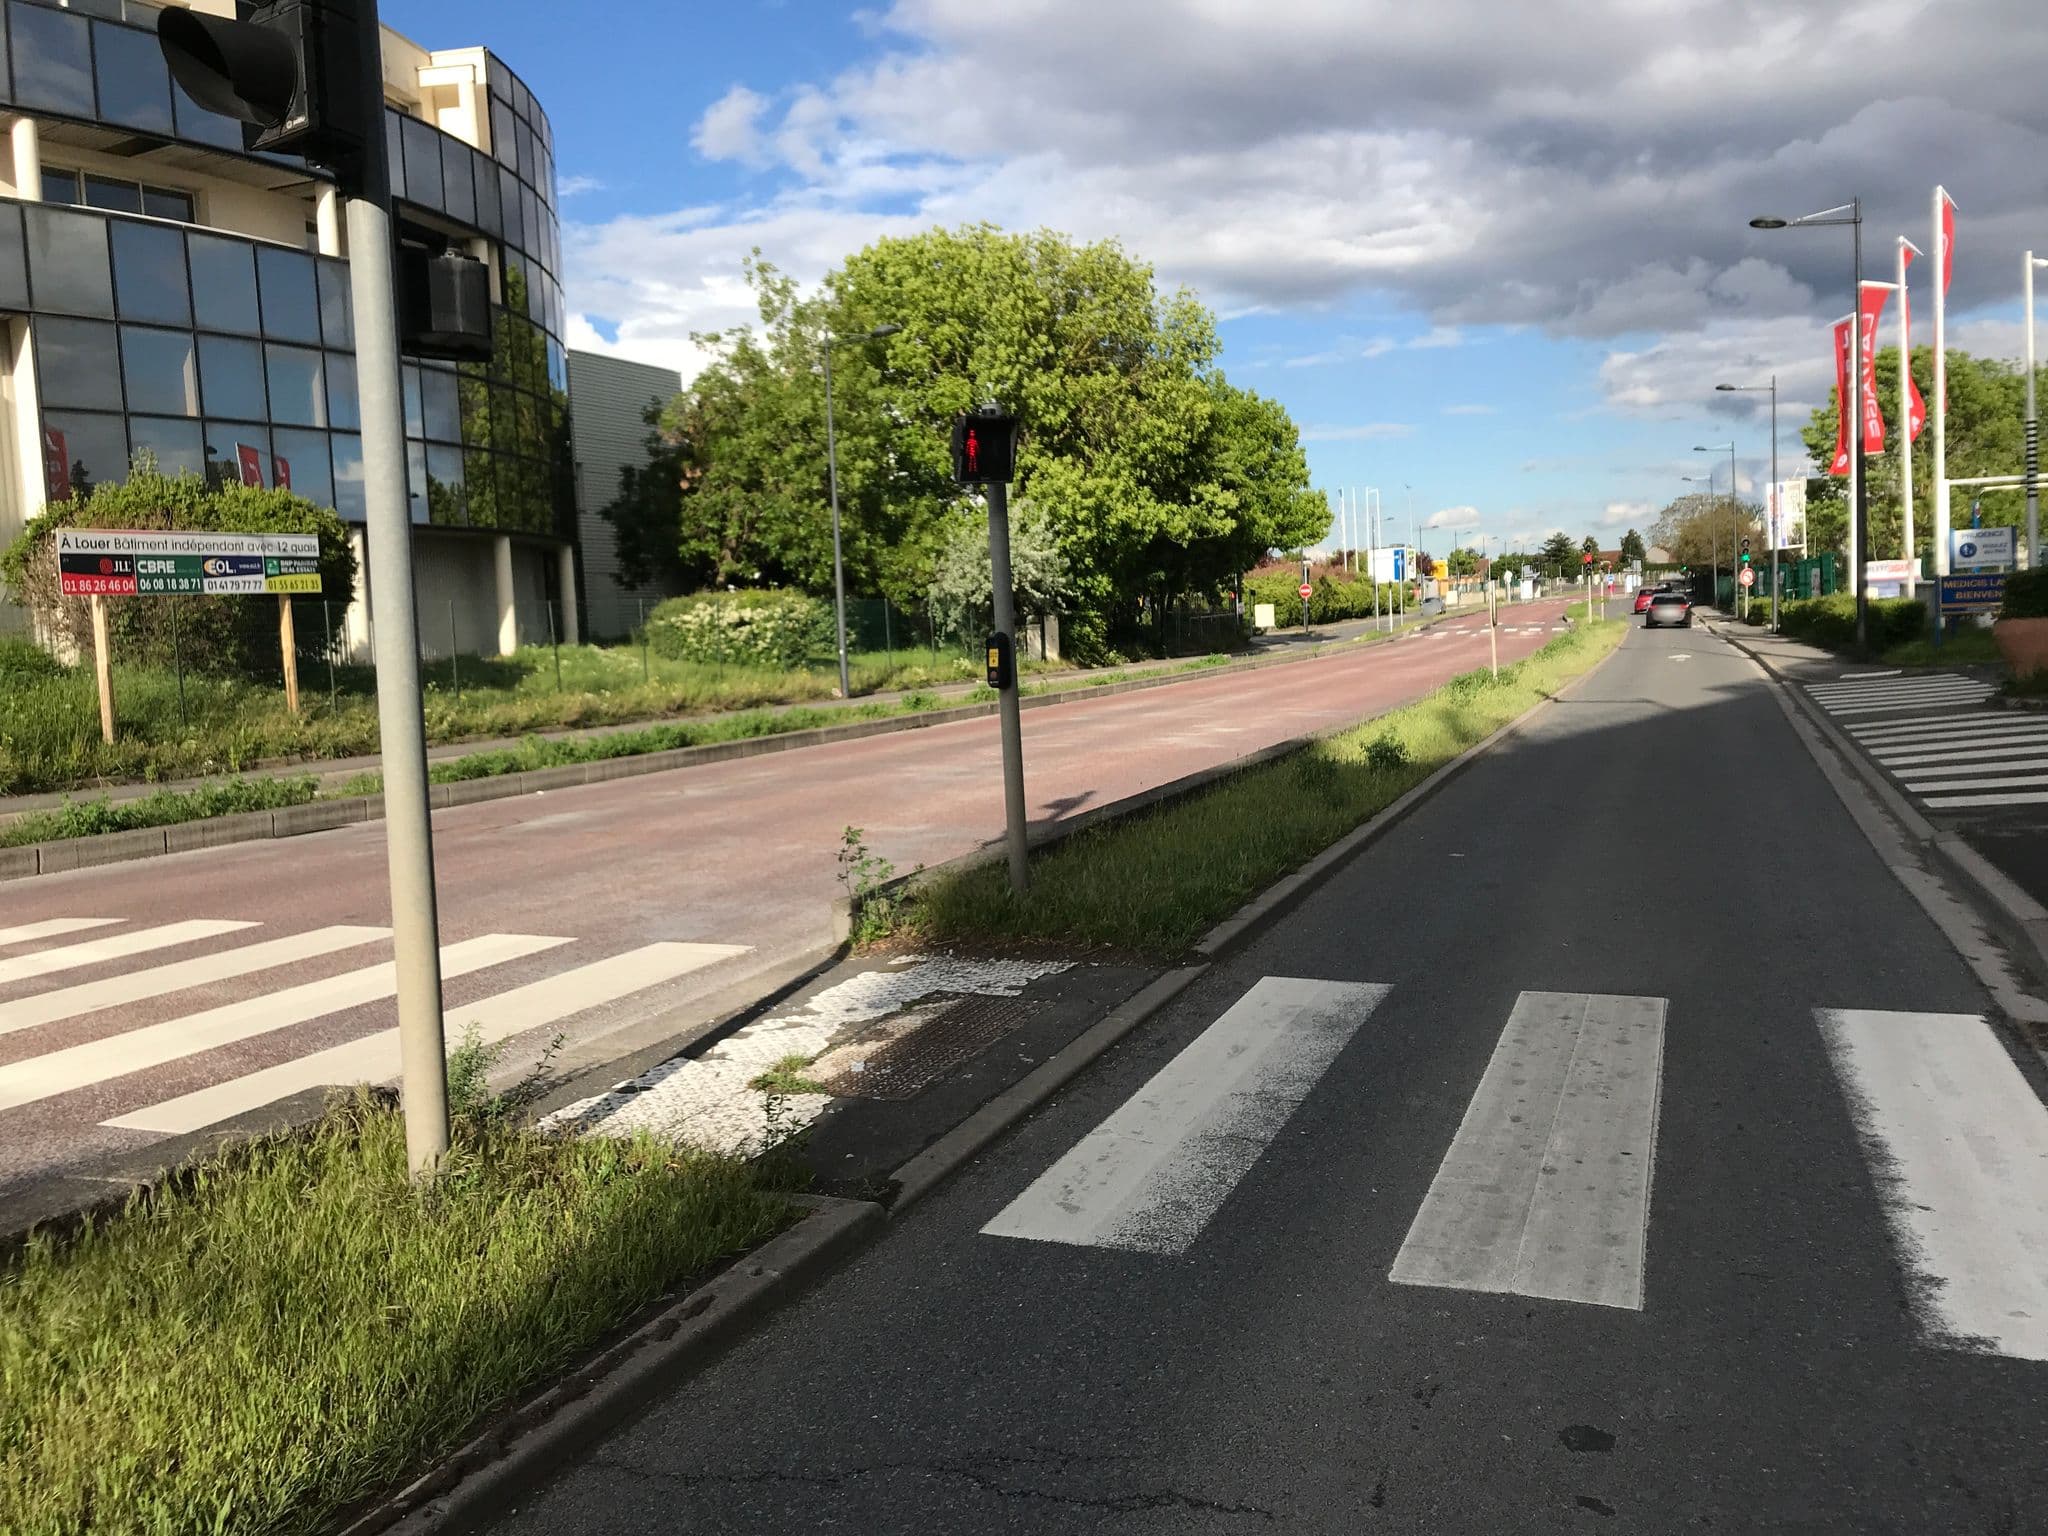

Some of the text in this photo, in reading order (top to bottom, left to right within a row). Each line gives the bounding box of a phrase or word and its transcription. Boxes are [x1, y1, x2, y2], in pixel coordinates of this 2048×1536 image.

[61, 533, 317, 554] À Louer Bâtiment indépendant avec 12 quais
[114, 560, 132, 573] JLL
[137, 559, 175, 574] CBRE
[64, 580, 135, 592] 01 86 26 46 04
[140, 577, 201, 590] 06 08 18 38 71
[207, 579, 263, 590] 01 41 79 77 77
[268, 579, 277, 589] 01
[1955, 591, 2002, 599] BIENVEN
